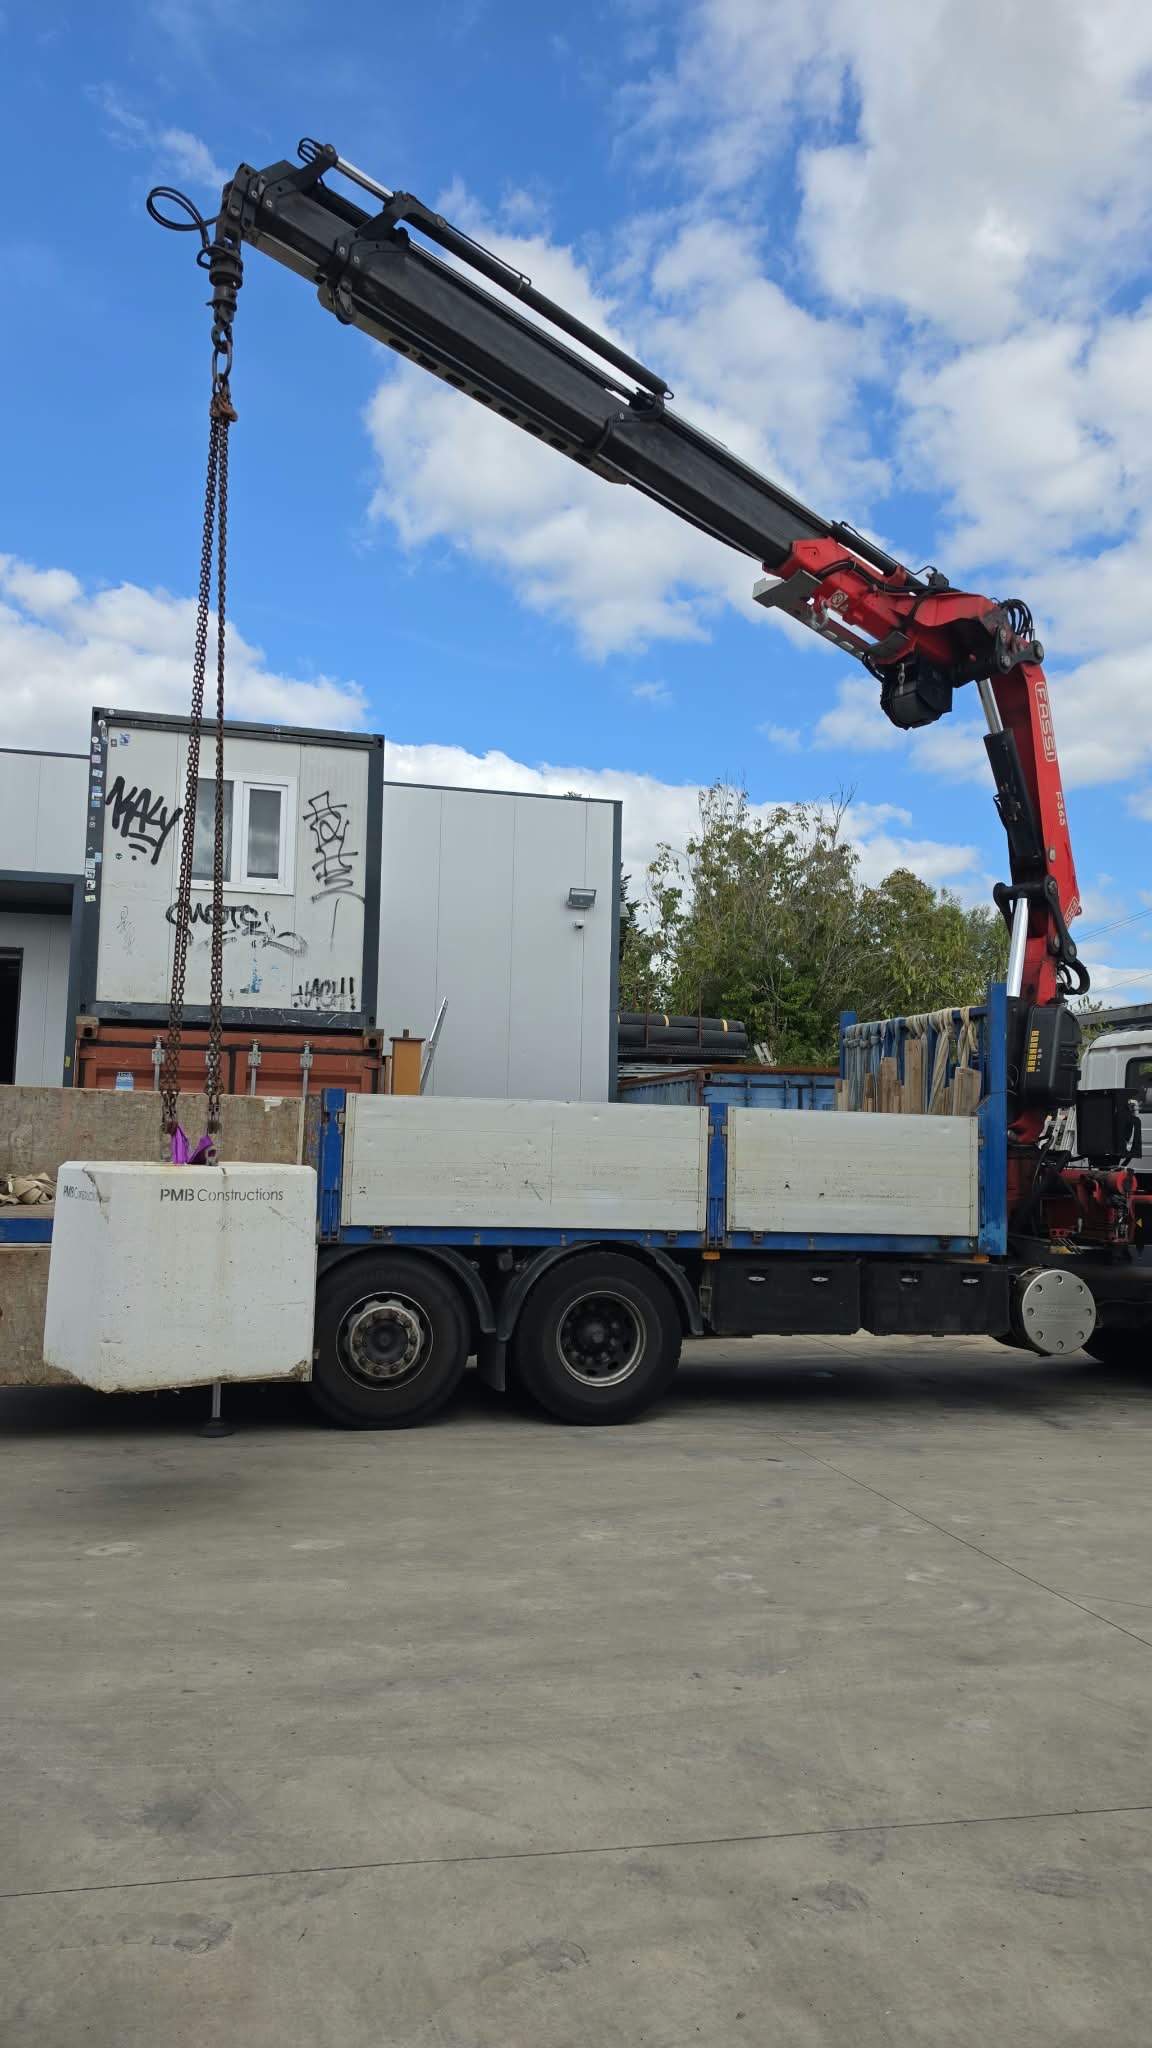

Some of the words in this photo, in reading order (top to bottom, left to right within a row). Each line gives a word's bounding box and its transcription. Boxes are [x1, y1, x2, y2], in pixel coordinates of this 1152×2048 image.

[1036, 686, 1055, 757] FASSI
[160, 1188, 195, 1202] PMB
[197, 1187, 284, 1202] Constructions
